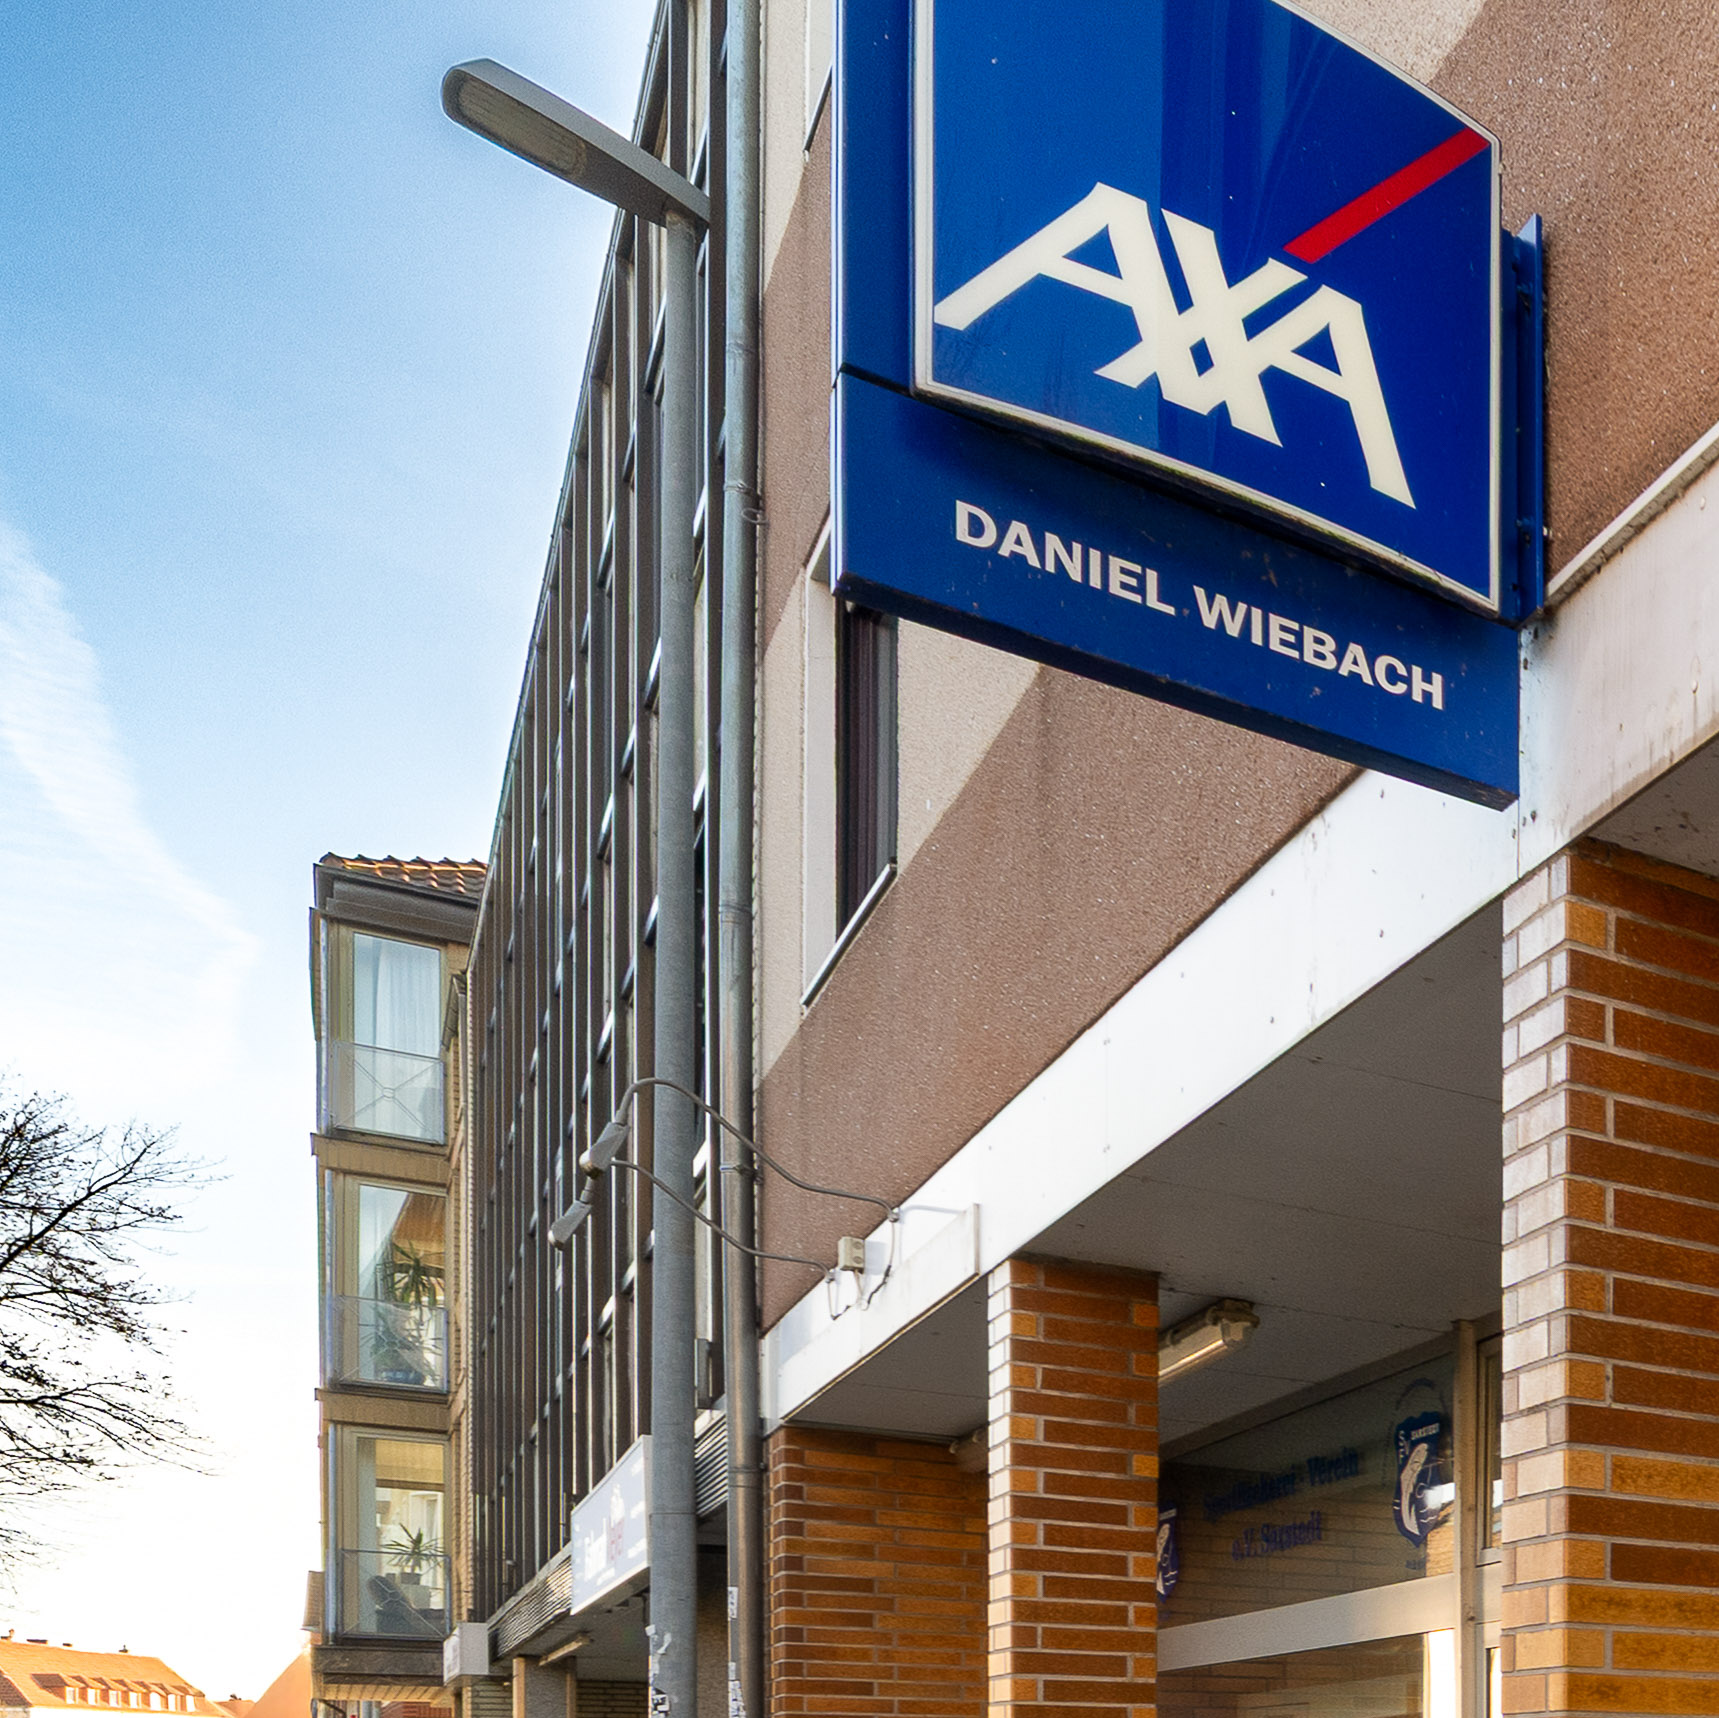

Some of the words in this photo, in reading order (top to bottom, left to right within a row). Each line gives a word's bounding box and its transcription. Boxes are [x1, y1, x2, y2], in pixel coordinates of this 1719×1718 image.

[934, 182, 1417, 510] AXA
[954, 500, 1176, 615] DANIEL
[1192, 584, 1446, 710] WIEBACH
